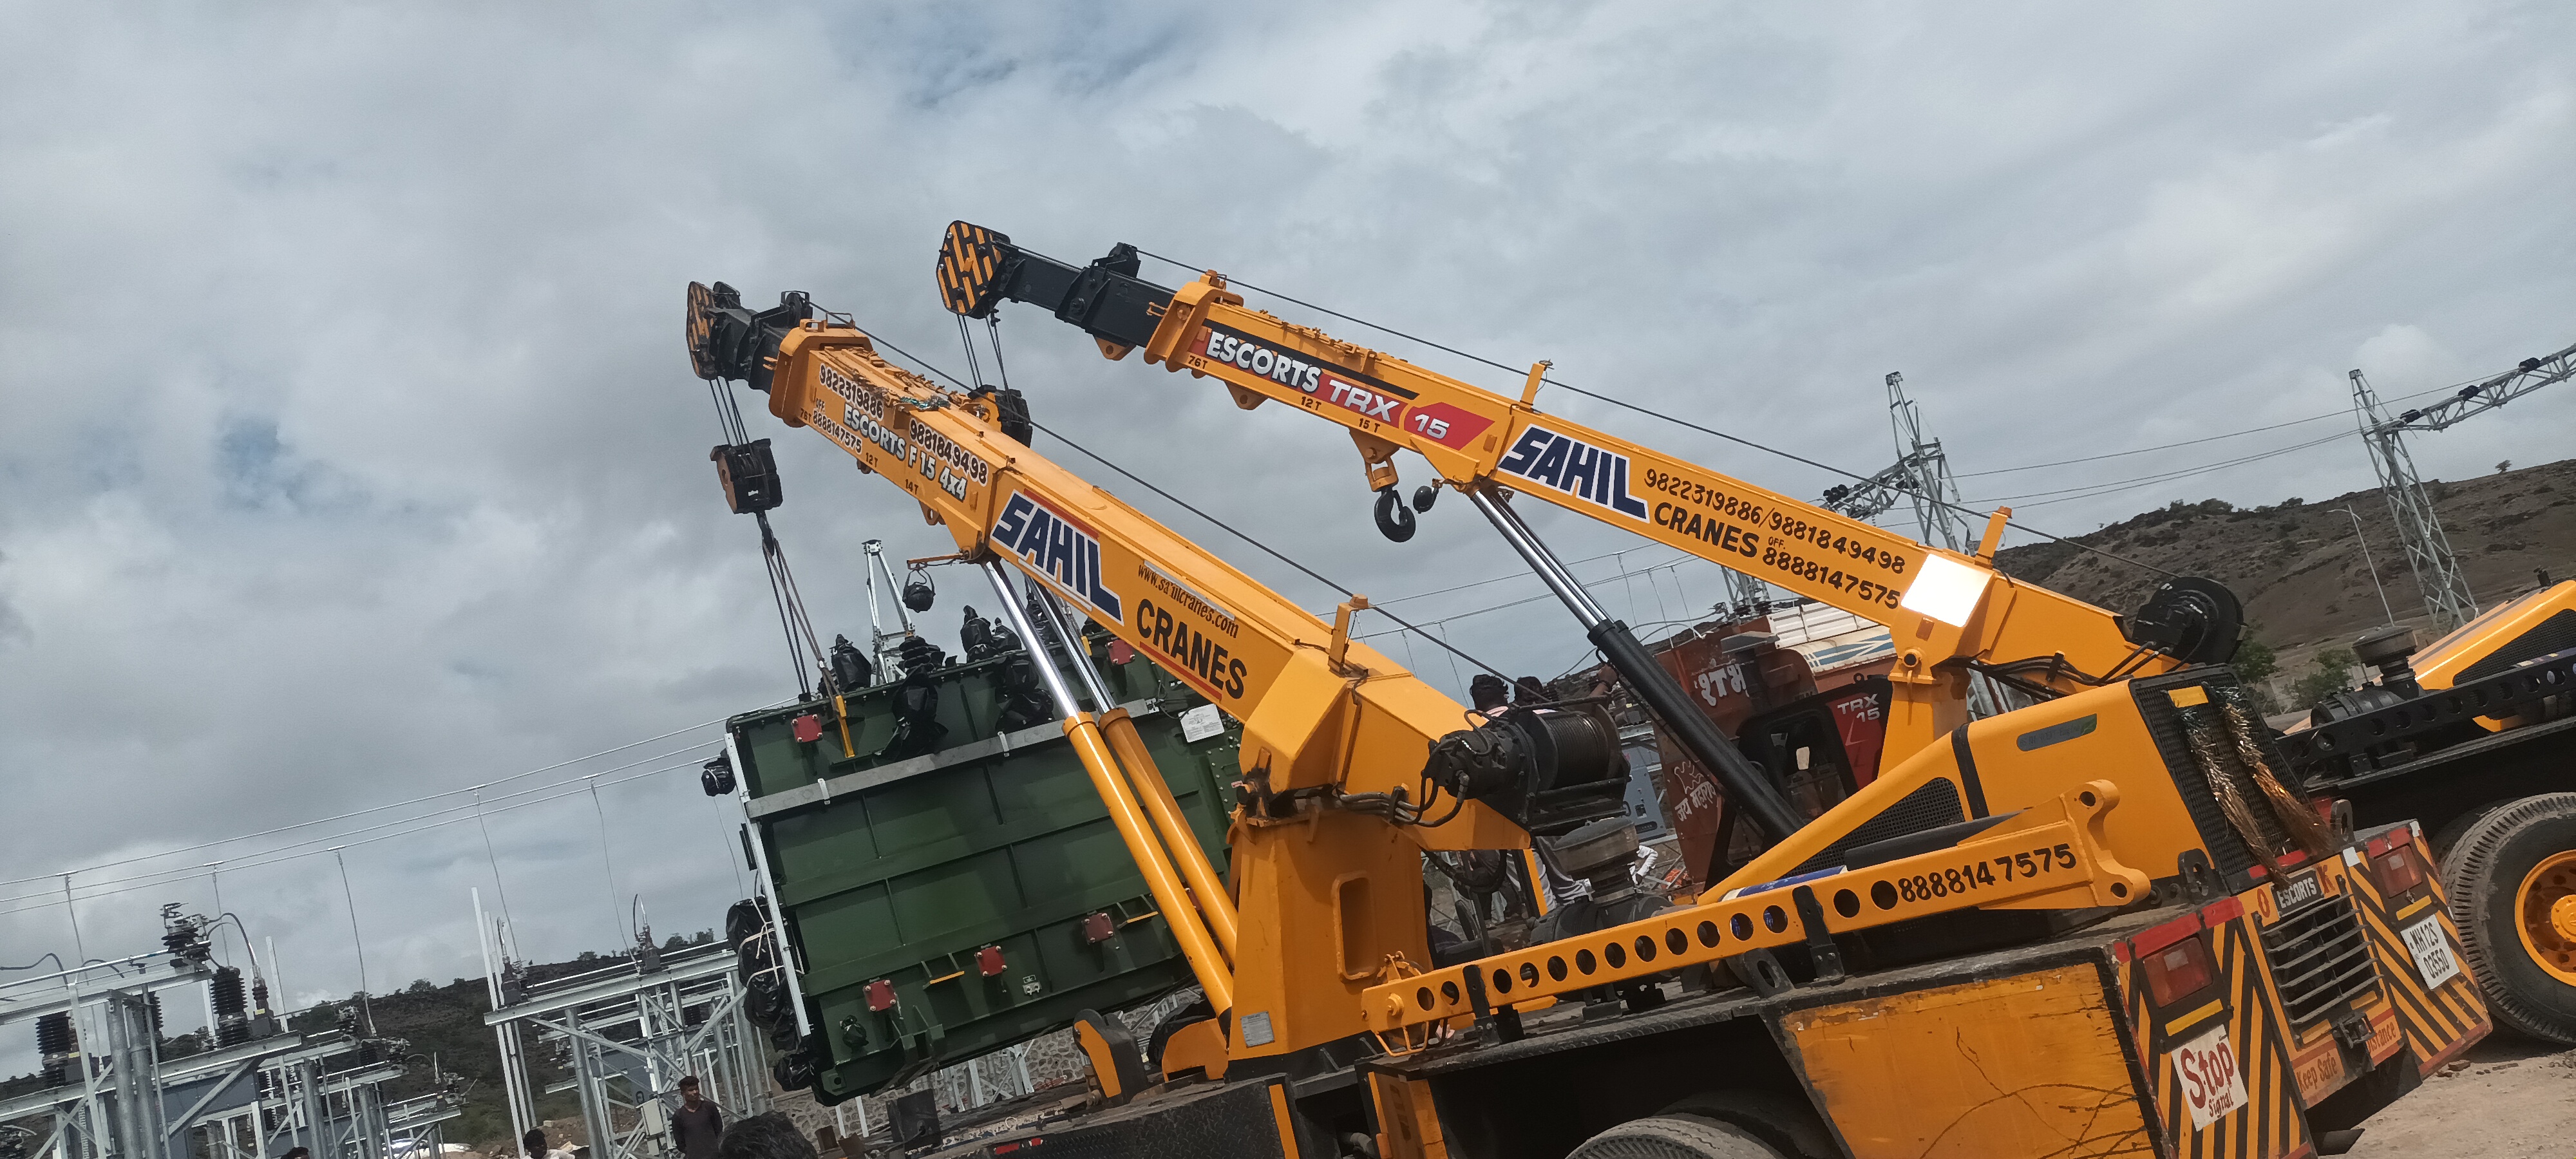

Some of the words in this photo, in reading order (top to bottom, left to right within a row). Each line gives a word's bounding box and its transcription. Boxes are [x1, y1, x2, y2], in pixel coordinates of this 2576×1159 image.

[819, 363, 884, 421] 9822319886
[1207, 331, 1321, 393] ESCORTS
[1329, 379, 1399, 422] TRX
[1415, 413, 1450, 439] 15
[813, 408, 862, 455] 8888147575
[844, 402, 906, 461] ESCORTS
[909, 444, 918, 468] F
[920, 451, 936, 481] 15
[909, 418, 989, 487] 9881849498
[1359, 418, 1370, 429] 15
[1374, 422, 1381, 433] T
[1498, 424, 1650, 523] SAHIL
[990, 489, 1124, 626] SAHIL
[1654, 502, 1760, 558] CRANES
[1768, 536, 1786, 549] OFF.
[1763, 547, 1900, 609] 8888147575
[1137, 599, 1247, 699] CRANES
[1837, 693, 1879, 715] TRX
[1857, 708, 1880, 722] 15
[1897, 843, 2077, 903] 8888147575
[2277, 877, 2317, 909] ESCORTS
[2180, 1042, 2234, 1109] Stop
[2296, 1066, 2318, 1094] Keep
[2317, 1051, 2338, 1082] Safe
[2209, 1087, 2234, 1118] signal
